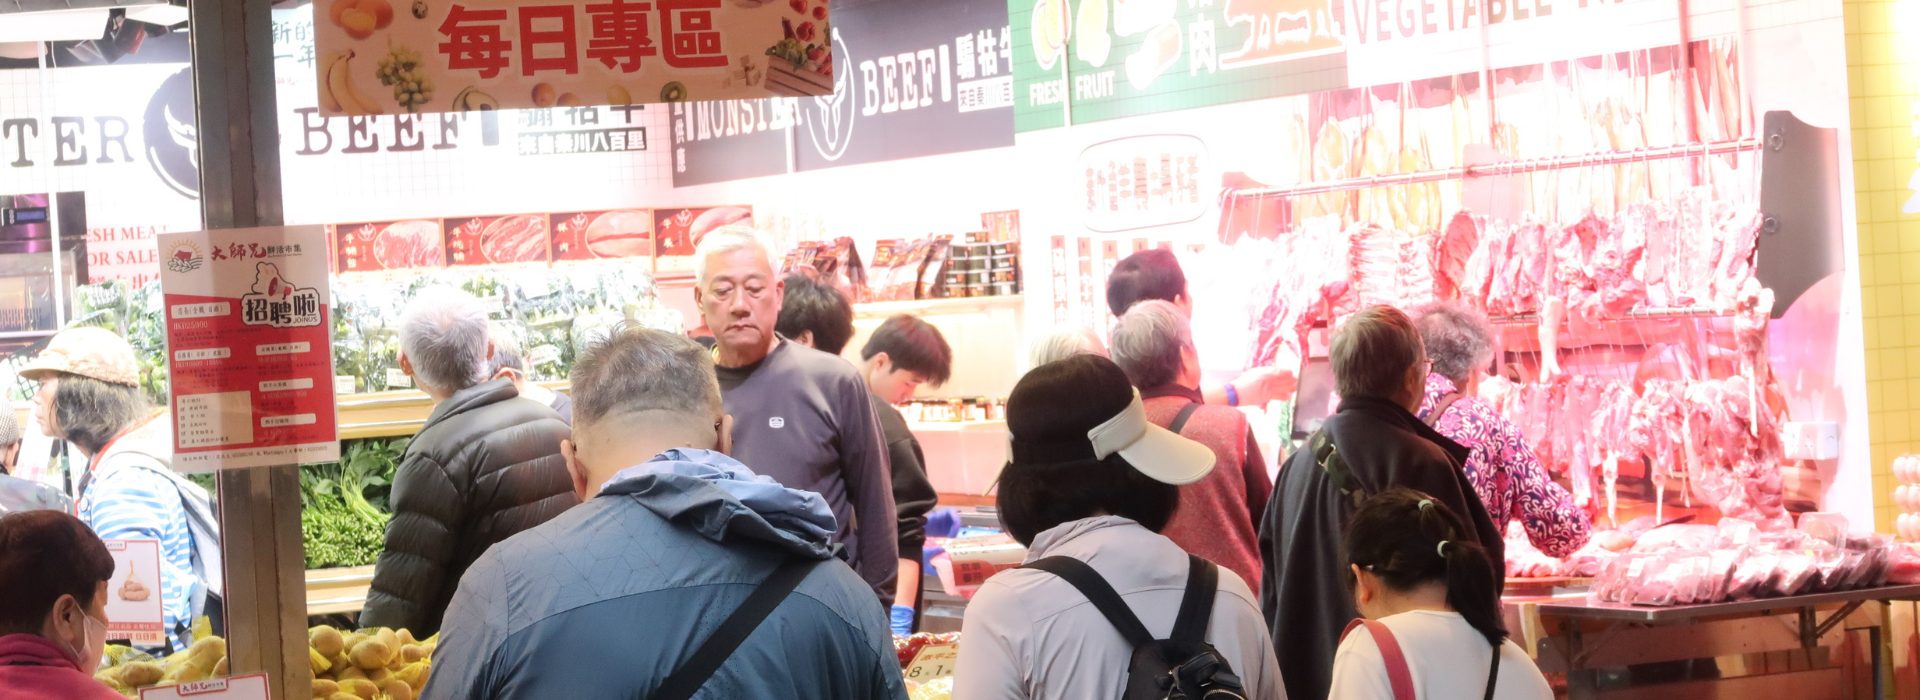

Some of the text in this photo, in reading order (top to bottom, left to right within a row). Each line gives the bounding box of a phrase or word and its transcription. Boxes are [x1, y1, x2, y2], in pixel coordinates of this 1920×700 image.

[439, 0, 729, 80] 每日專區
[860, 49, 937, 117] BEEF
[1075, 70, 1115, 101] FRUIT
[3, 116, 134, 168] TER
[116, 248, 158, 265] SALE
[211, 241, 267, 262] 大師兄
[245, 293, 315, 324] 招聘啦
